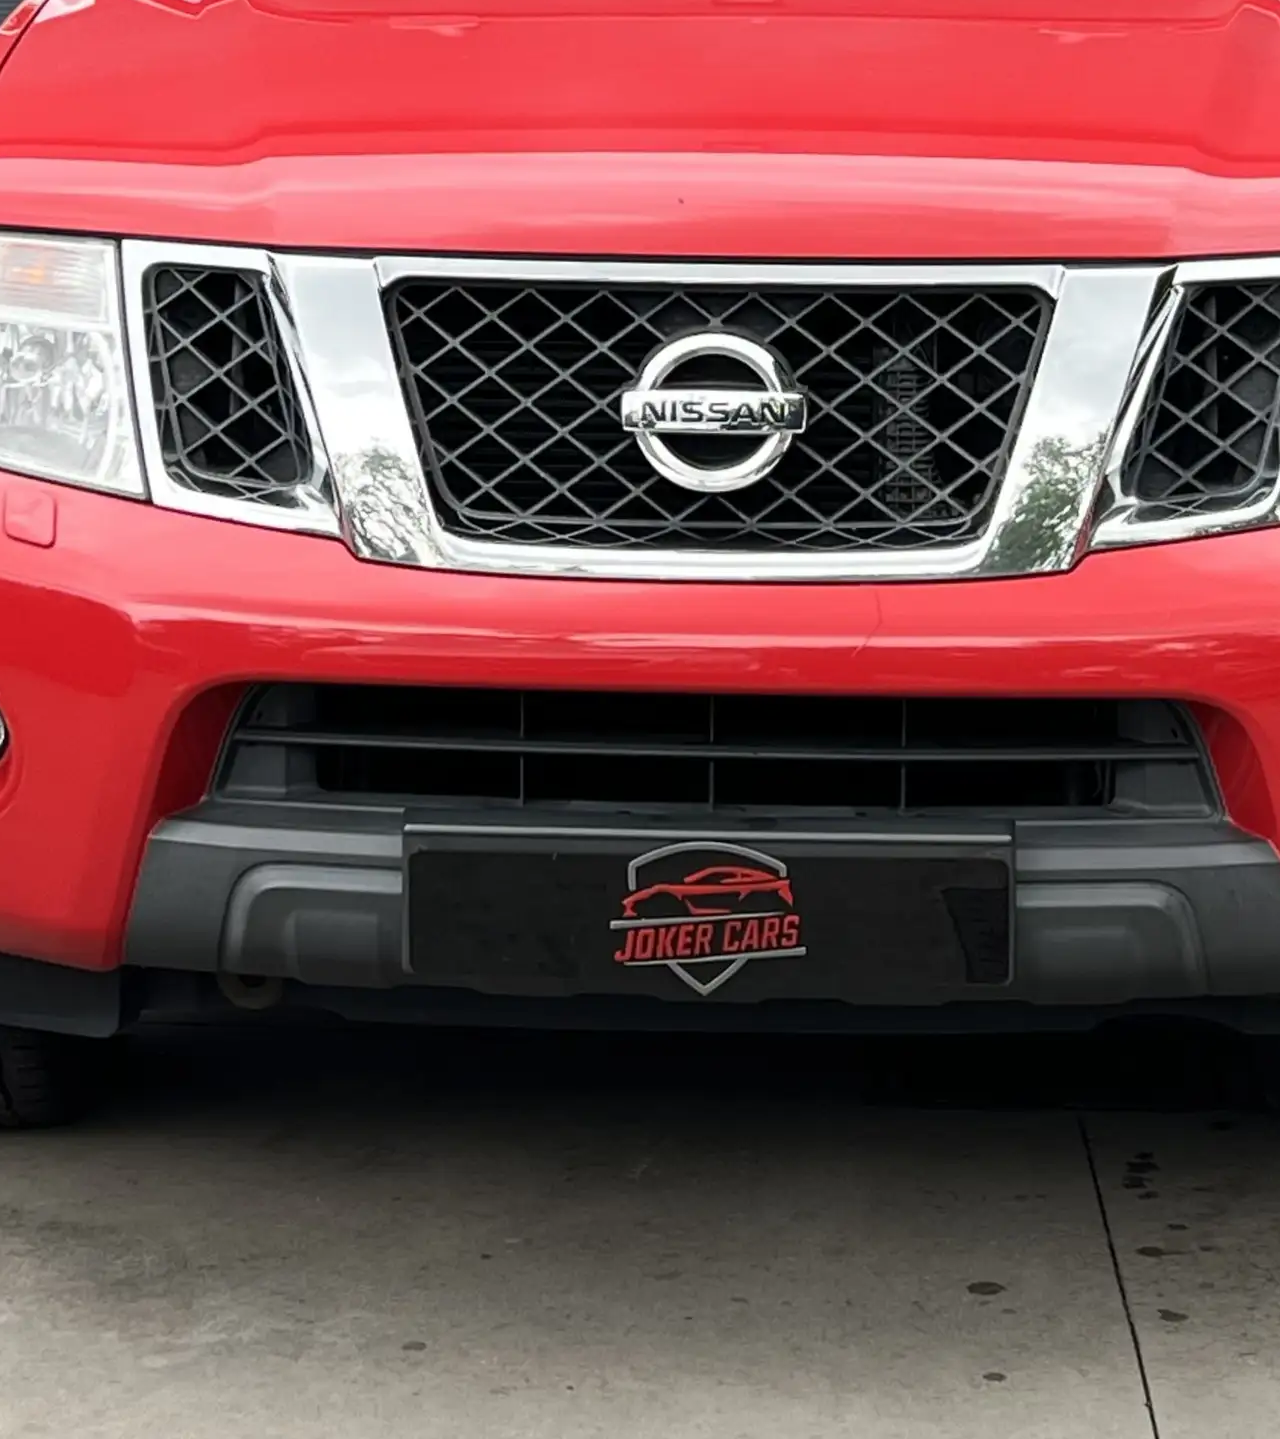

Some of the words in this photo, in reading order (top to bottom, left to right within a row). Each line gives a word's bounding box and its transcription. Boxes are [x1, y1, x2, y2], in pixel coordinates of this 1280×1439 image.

[640, 401, 787, 425] NISSAN
[614, 923, 714, 962] JOKER
[722, 914, 800, 952] CARS
